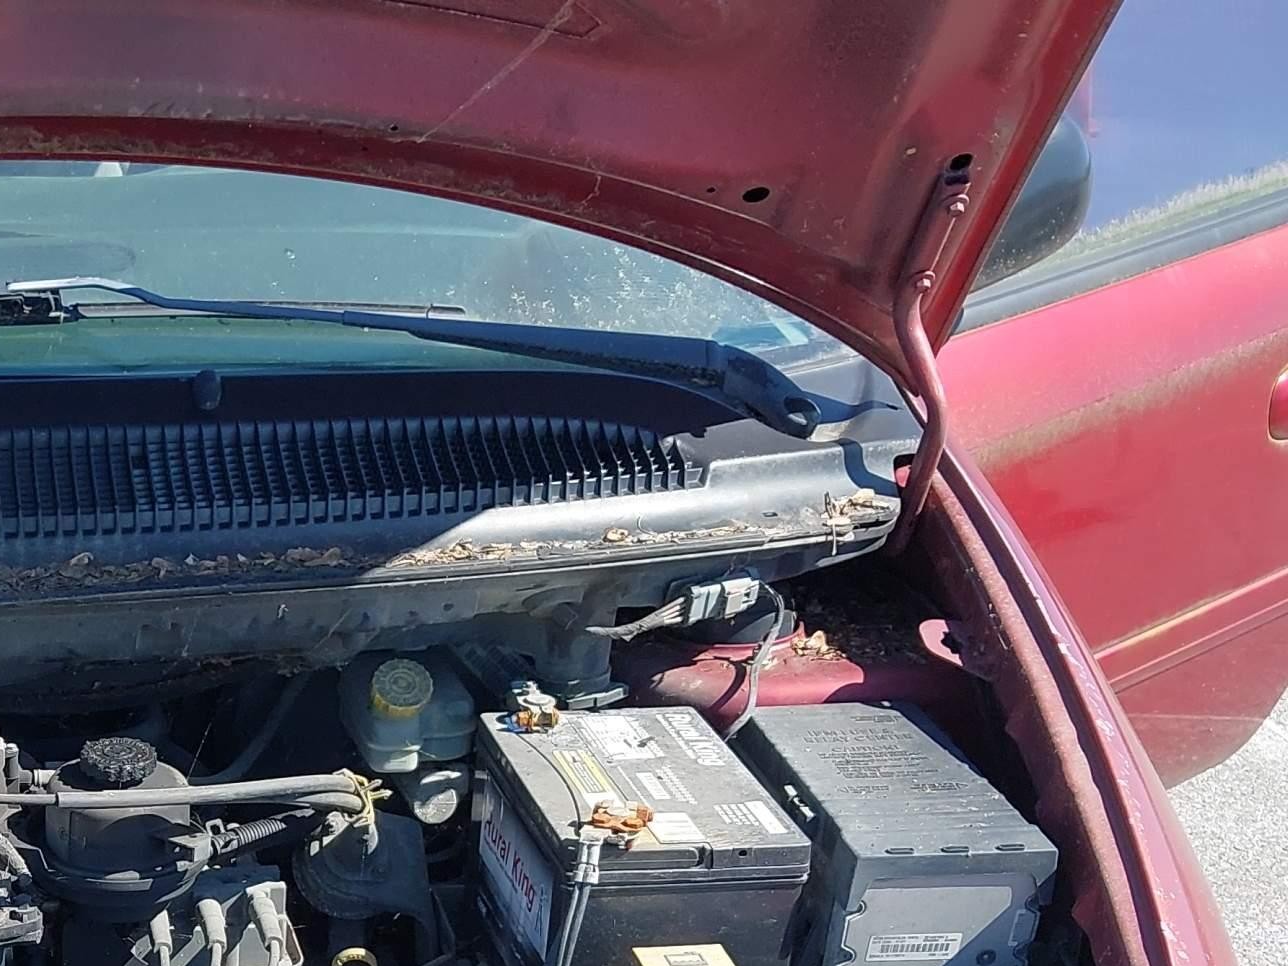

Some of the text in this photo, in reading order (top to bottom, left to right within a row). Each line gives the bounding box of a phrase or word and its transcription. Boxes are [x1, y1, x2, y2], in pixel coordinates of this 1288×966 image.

[664, 712, 708, 740] Rural
[689, 739, 726, 766] King
[511, 850, 537, 914] King
